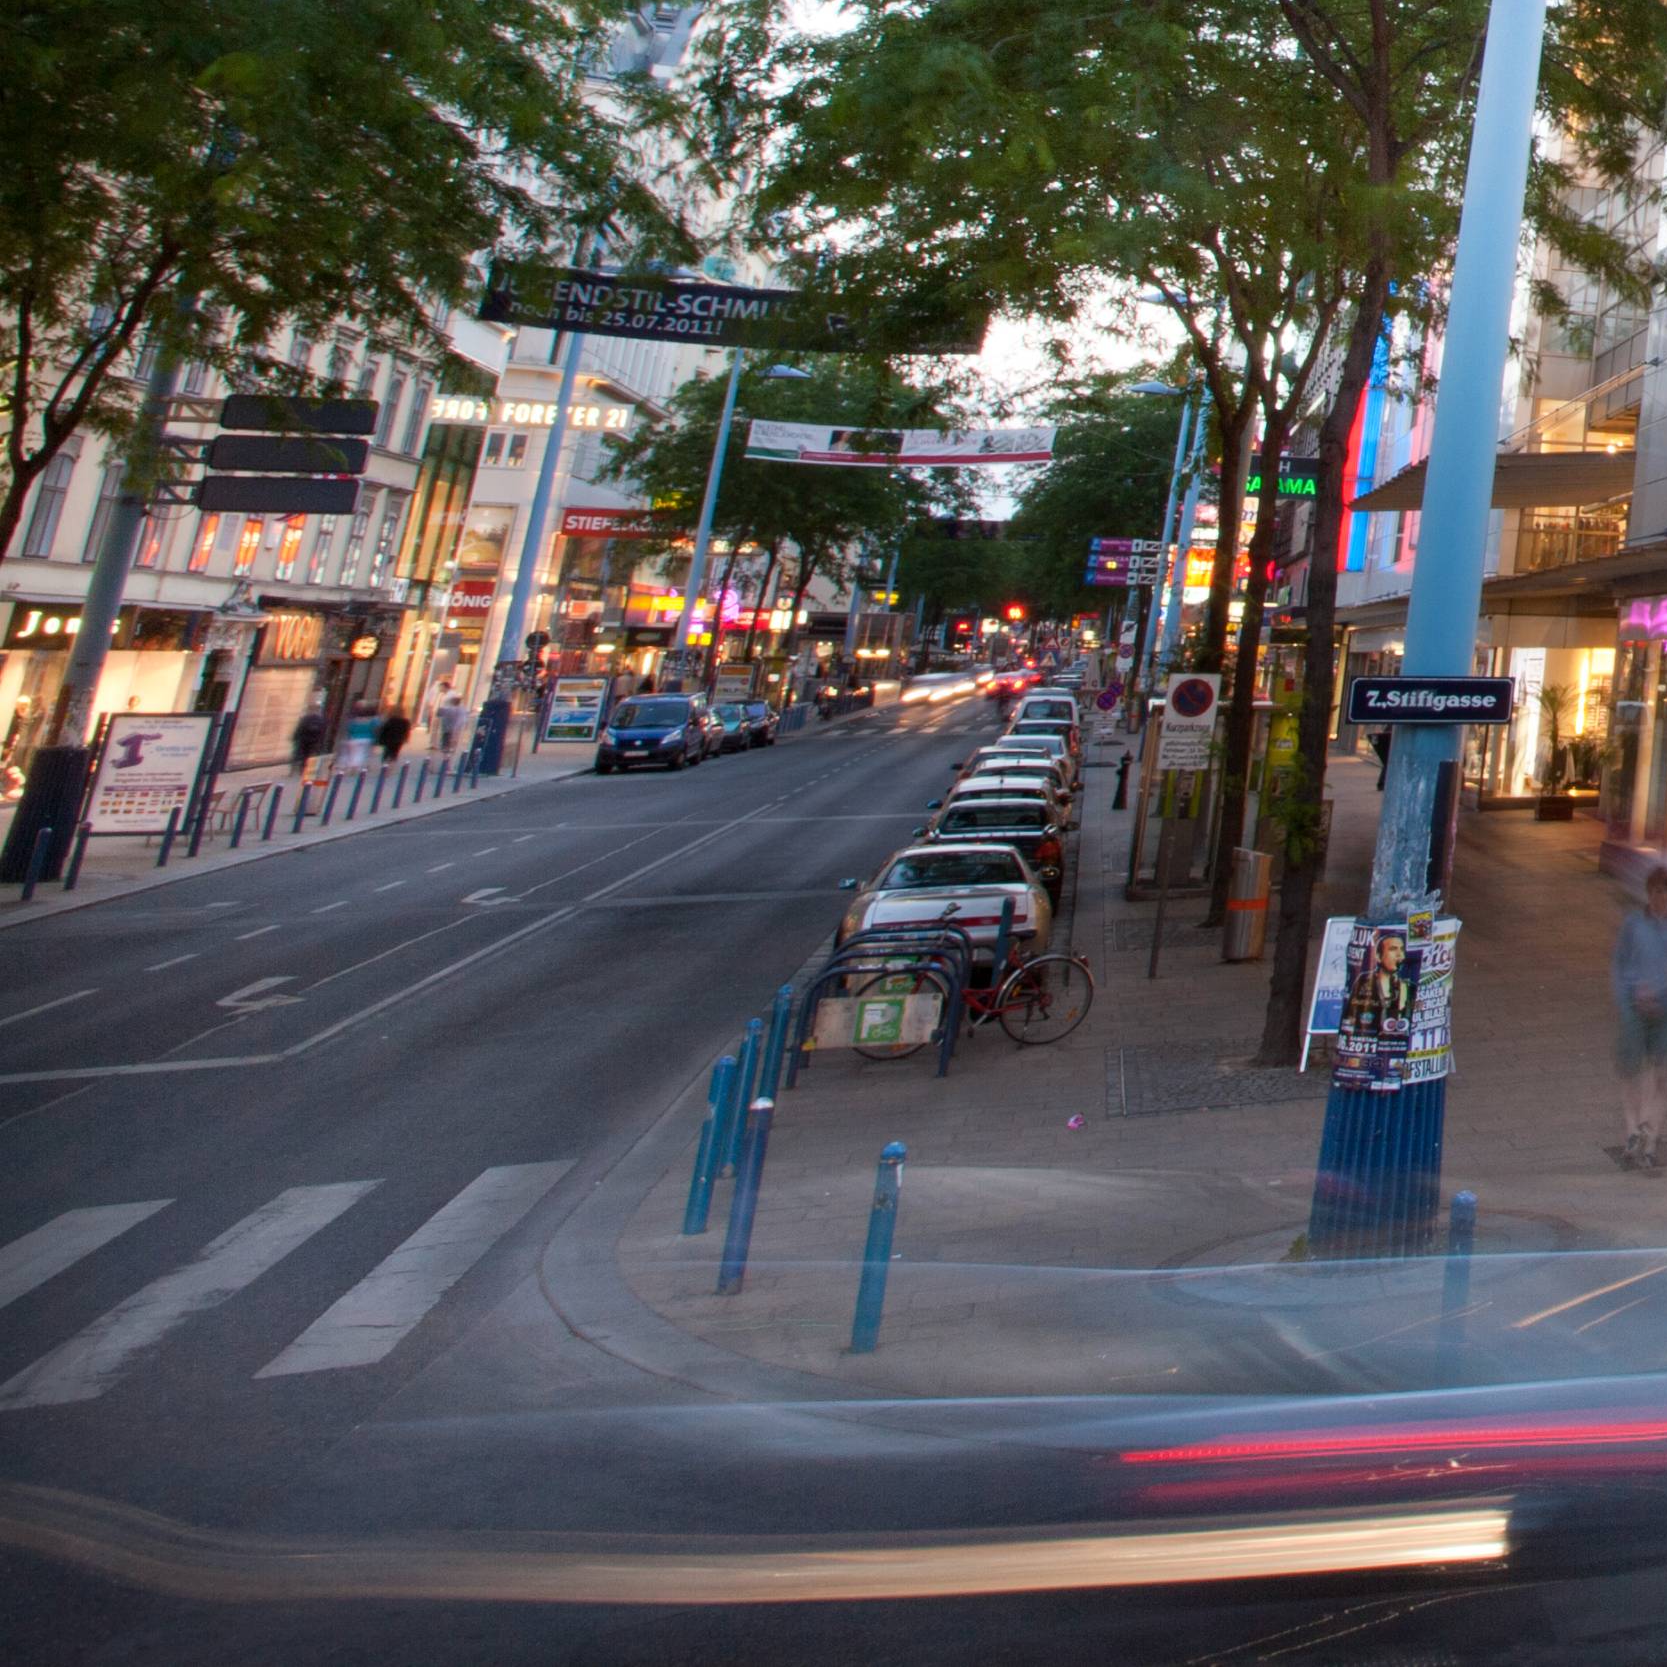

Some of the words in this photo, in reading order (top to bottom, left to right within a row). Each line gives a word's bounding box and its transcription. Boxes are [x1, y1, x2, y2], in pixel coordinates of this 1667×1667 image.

[567, 305, 594, 324] bis
[601, 310, 724, 335] 25.07.2011!
[502, 402, 600, 426] FOREER
[605, 409, 629, 428] 21
[17, 610, 121, 638] Jons
